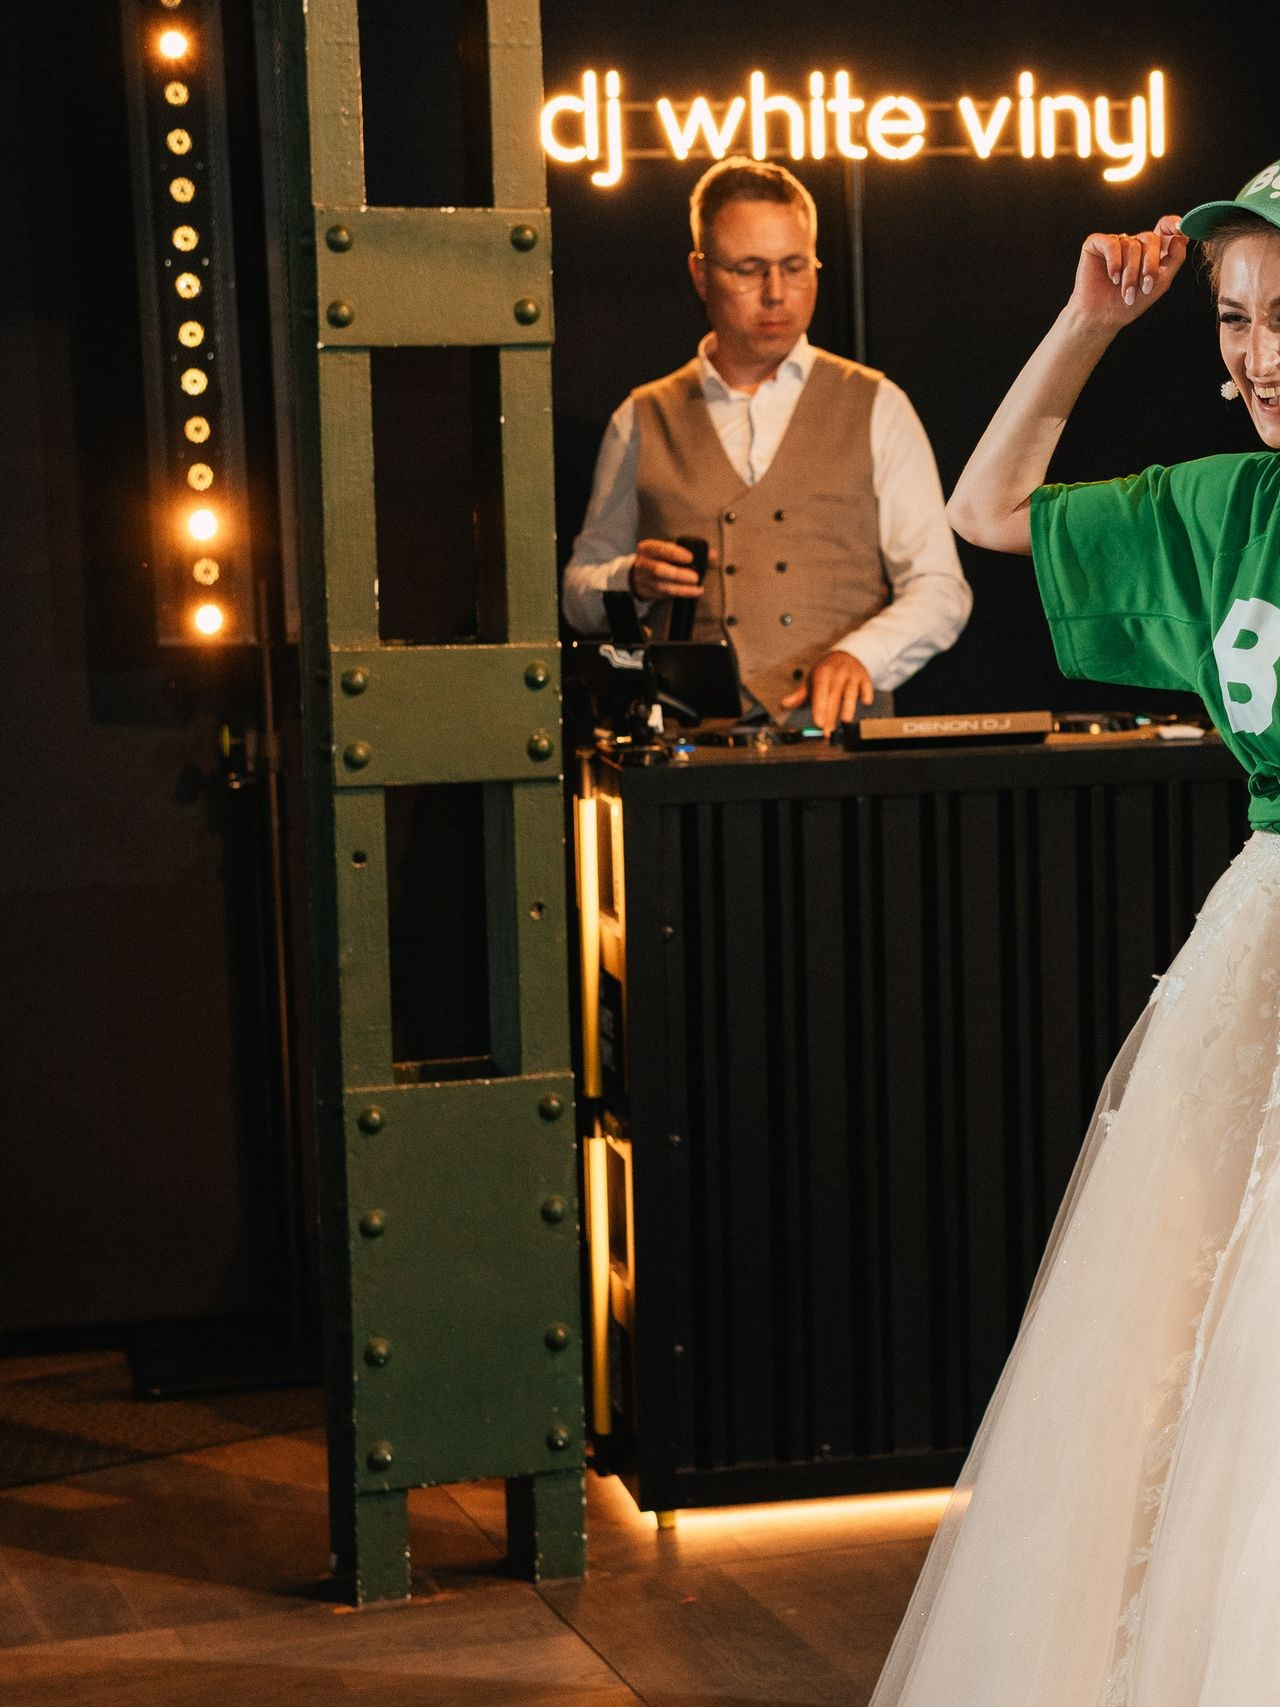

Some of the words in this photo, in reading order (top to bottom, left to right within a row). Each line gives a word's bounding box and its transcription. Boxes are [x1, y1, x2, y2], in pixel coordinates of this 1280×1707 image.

[541, 70, 622, 187] dj
[657, 70, 926, 161] white
[957, 69, 1168, 182] vinyl
[902, 720, 978, 734] DENON
[982, 718, 1010, 730] DJ
